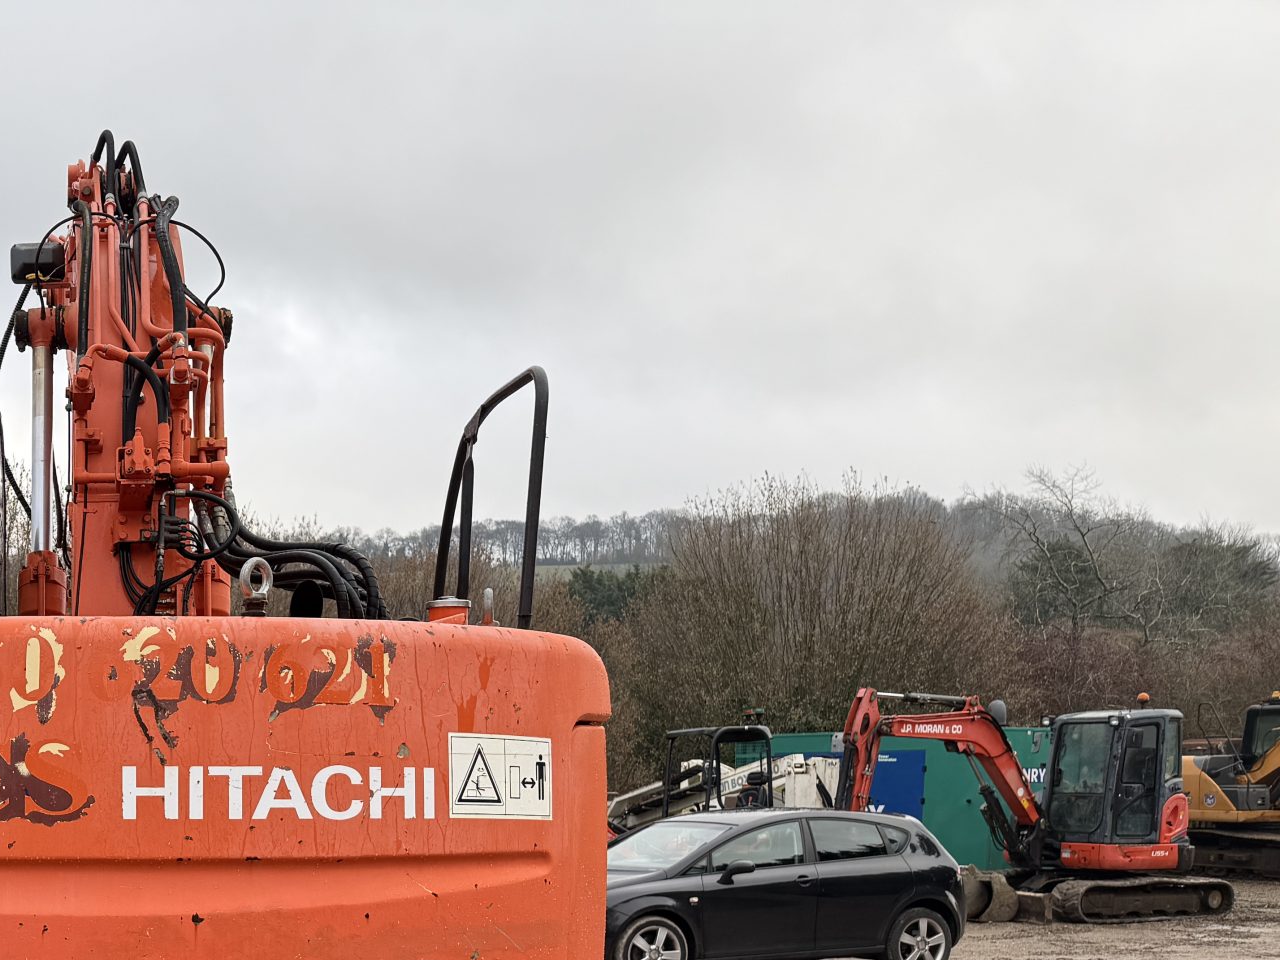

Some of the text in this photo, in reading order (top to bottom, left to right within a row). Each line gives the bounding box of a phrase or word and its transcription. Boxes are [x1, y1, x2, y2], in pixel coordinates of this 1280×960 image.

[915, 723, 945, 734] MORAN
[951, 724, 963, 734] CO
[121, 765, 436, 820] HITACHI
